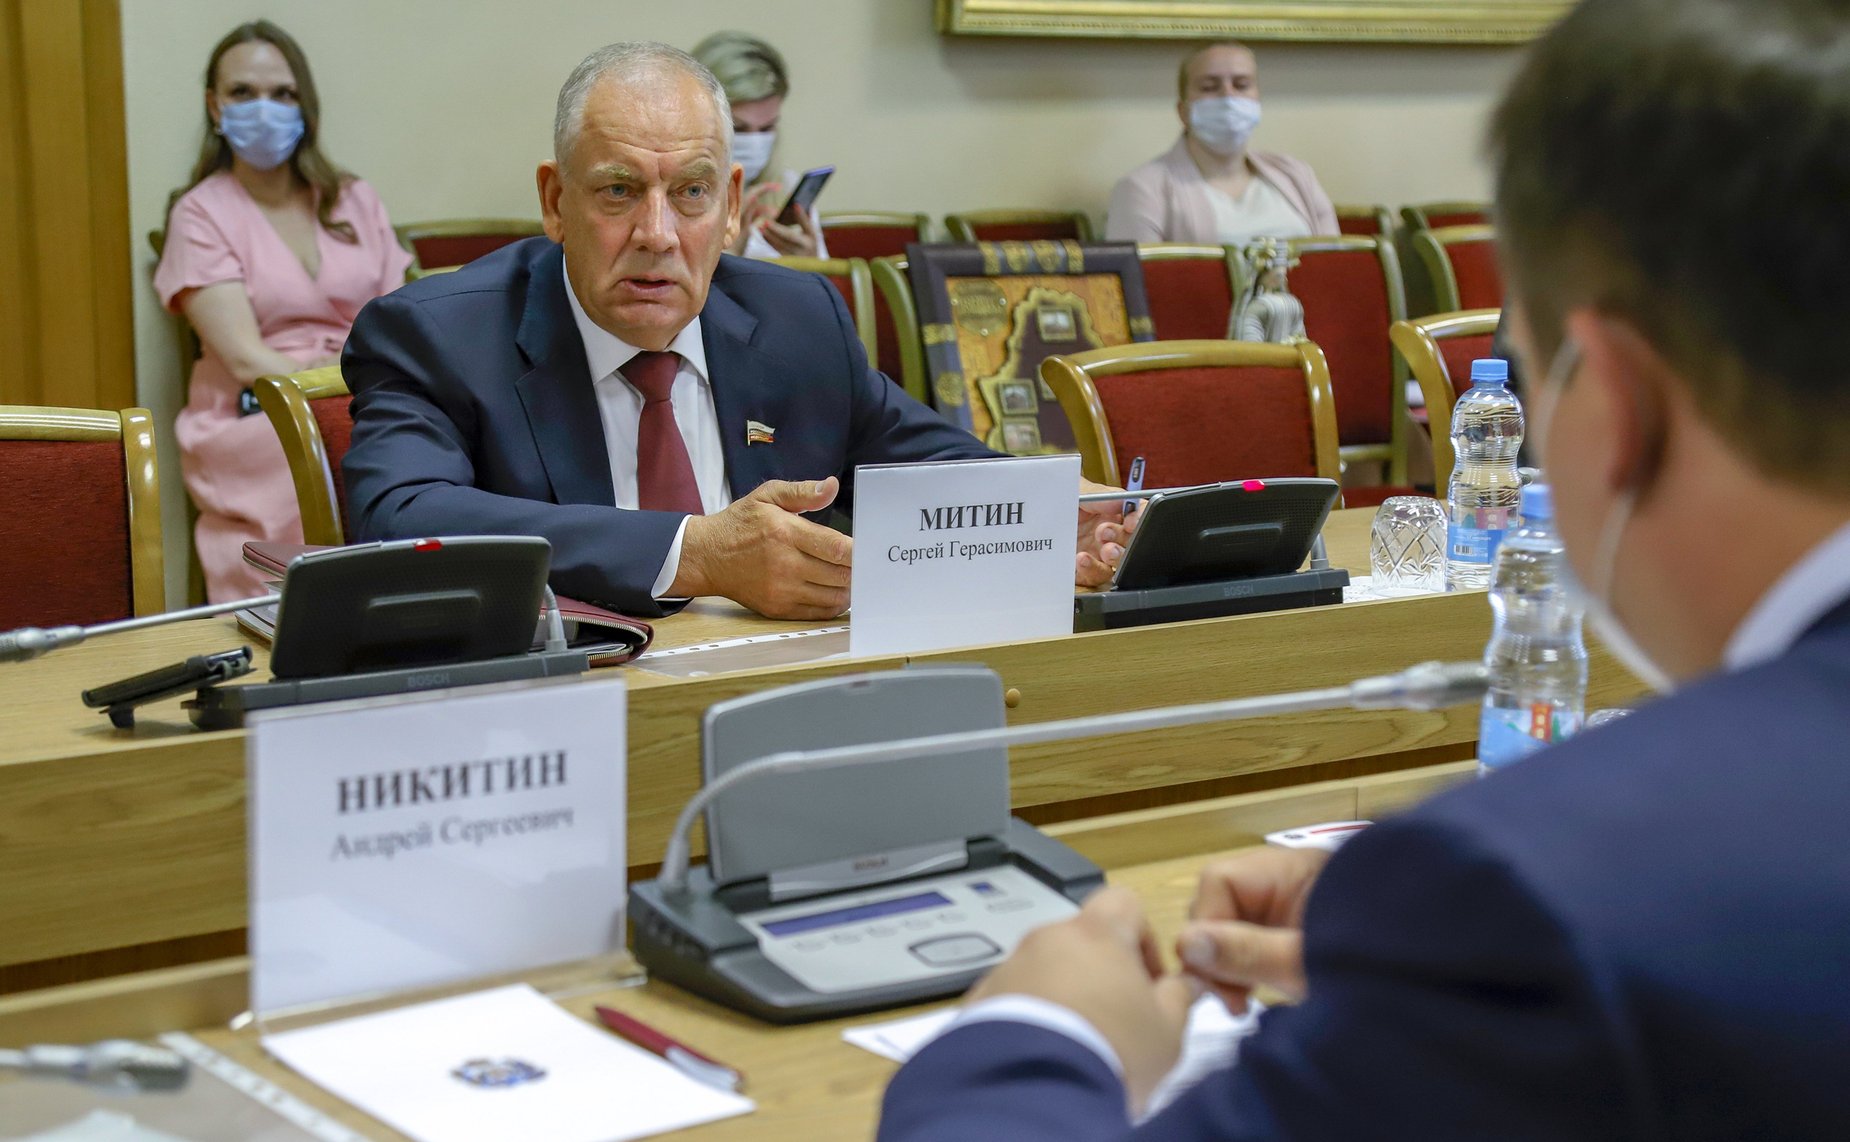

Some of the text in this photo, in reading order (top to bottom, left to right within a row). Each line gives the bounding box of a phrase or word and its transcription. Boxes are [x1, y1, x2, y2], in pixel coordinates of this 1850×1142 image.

[919, 502, 1025, 531] МИТИН
[888, 538, 1053, 565] Сергей Герасимович
[407, 673, 450, 687] BOSCH
[337, 750, 568, 815] НИКИТИН
[330, 807, 575, 861] Андрей Сергеевич
